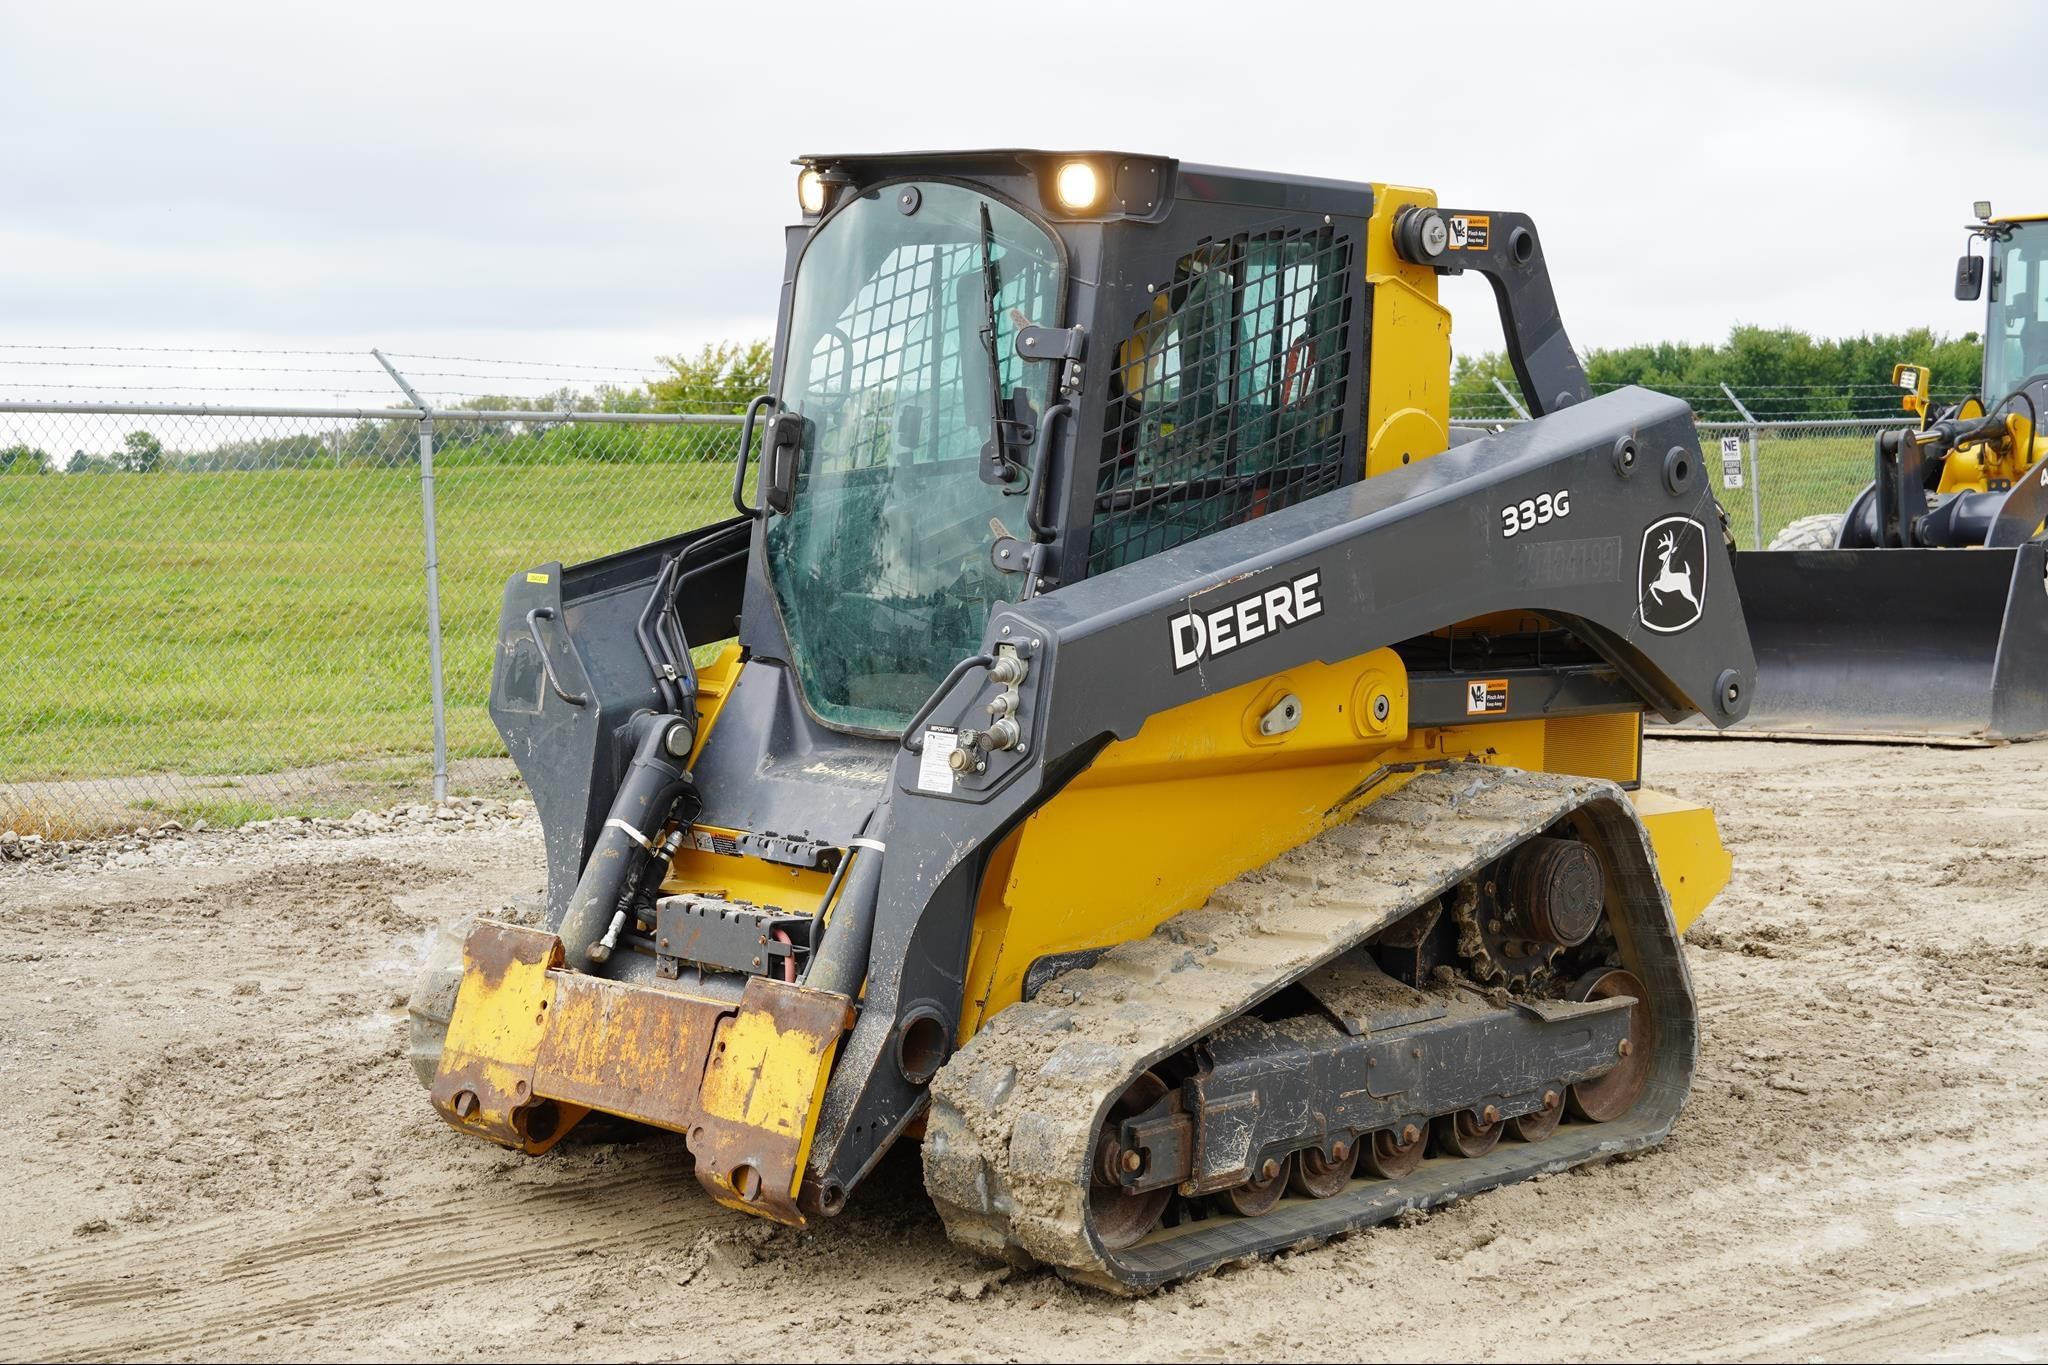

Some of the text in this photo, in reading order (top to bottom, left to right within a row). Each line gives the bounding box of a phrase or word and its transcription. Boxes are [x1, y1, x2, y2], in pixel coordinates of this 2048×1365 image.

[1724, 440, 1738, 451] NE
[1502, 490, 1570, 537] 333G
[1170, 572, 1322, 670] DEERE
[930, 725, 955, 734] IMPORTANT
